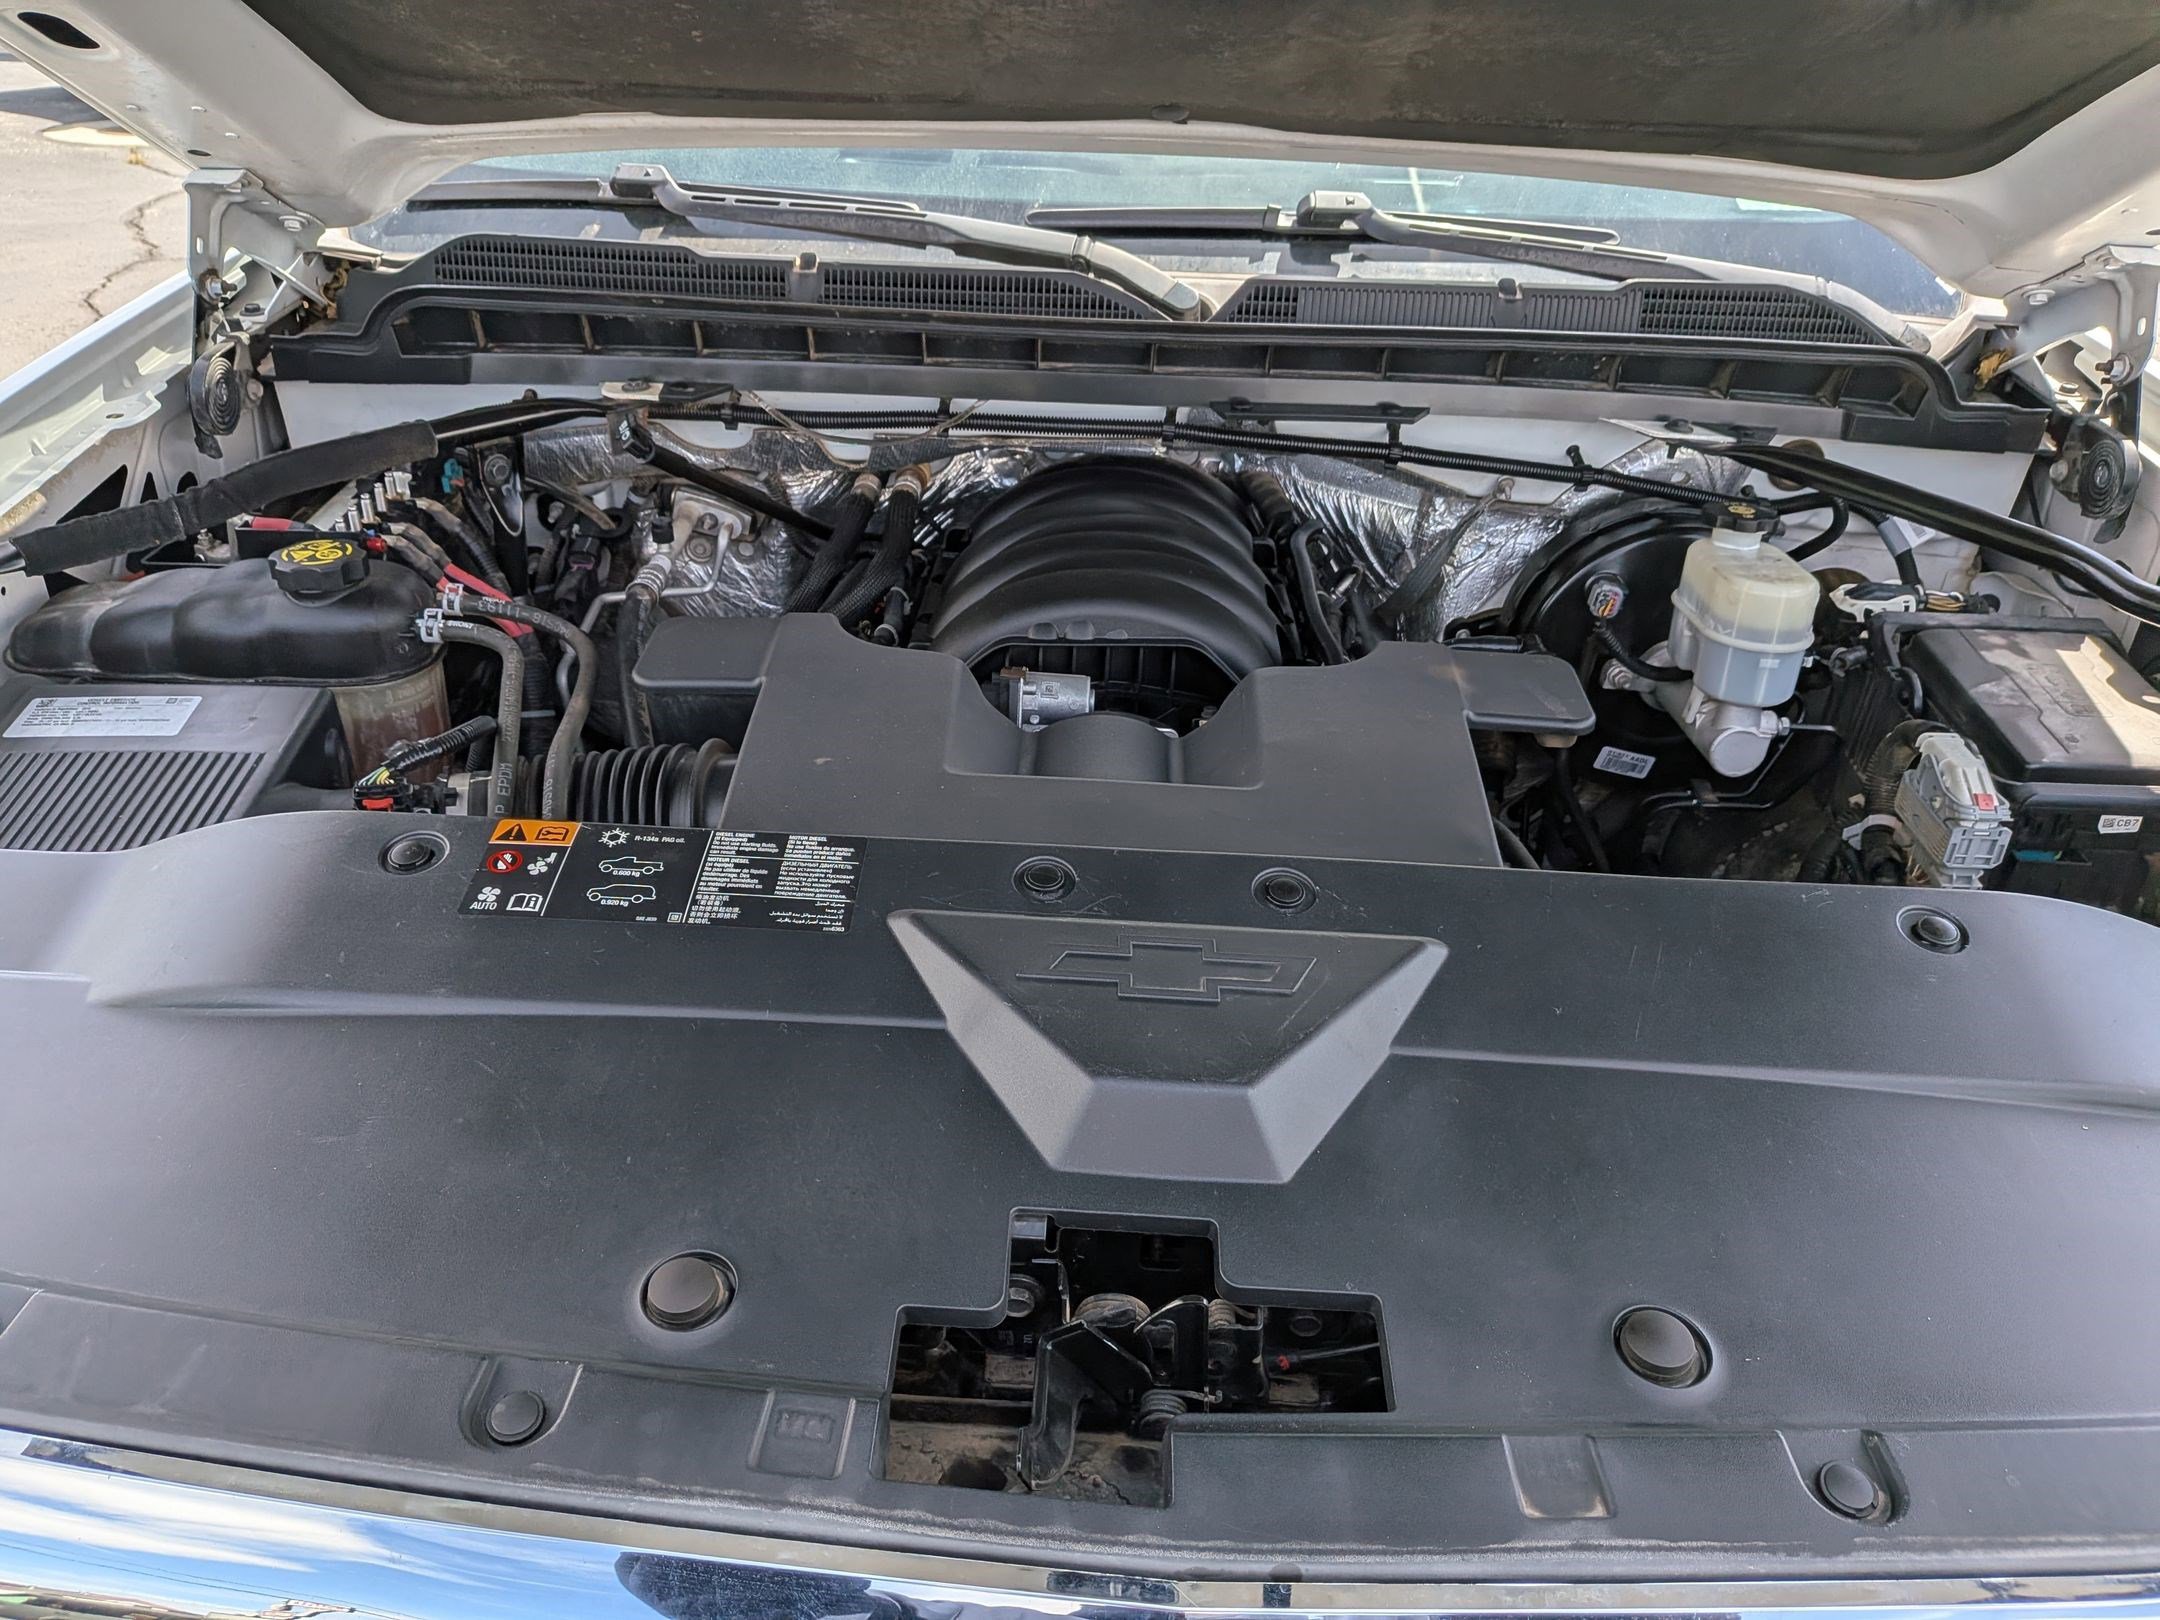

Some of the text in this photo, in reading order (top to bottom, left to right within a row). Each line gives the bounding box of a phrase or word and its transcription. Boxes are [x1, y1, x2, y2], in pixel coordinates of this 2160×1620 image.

[497, 763, 513, 796] EPDM
[2116, 819, 2139, 827] CB7
[469, 902, 498, 910] AUTO
